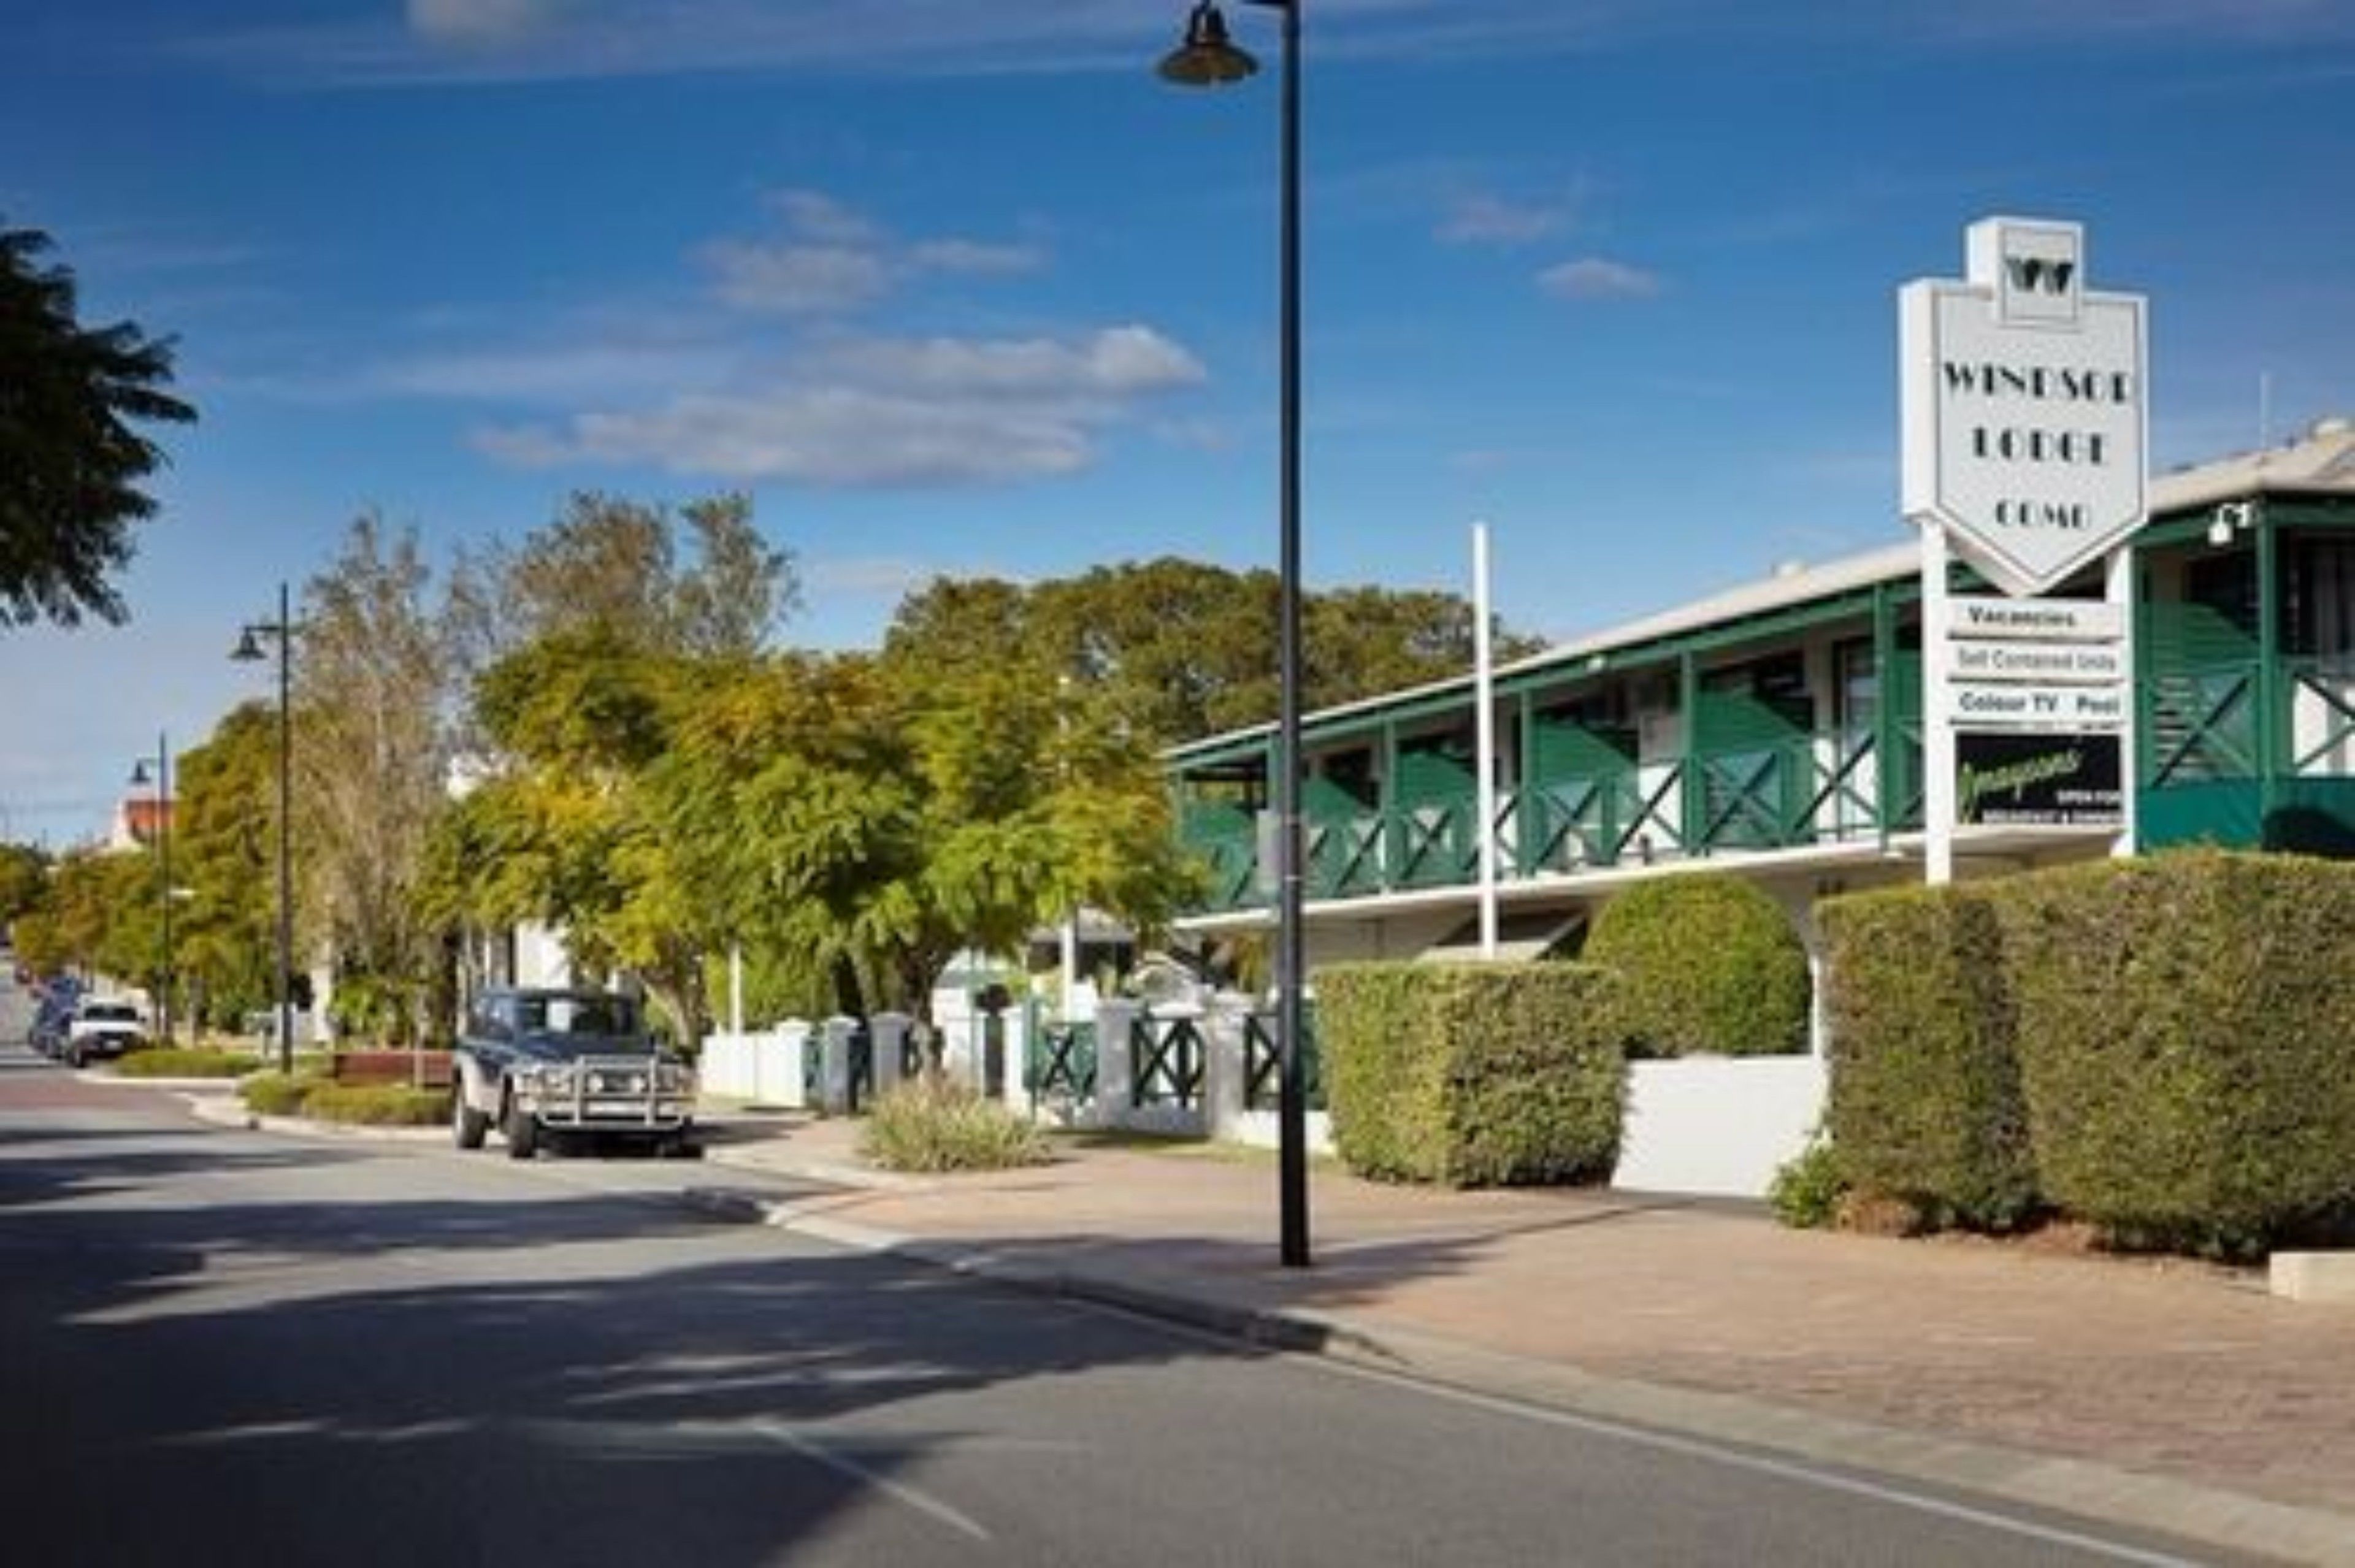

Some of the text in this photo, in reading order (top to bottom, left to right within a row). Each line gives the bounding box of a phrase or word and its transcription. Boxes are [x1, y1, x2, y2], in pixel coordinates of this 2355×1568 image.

[1944, 362, 2132, 403] WINDSOR
[1974, 427, 2108, 466] LODGE
[1968, 605, 2075, 628] Vacancies
[1959, 692, 2120, 715] Colour TV Pool
